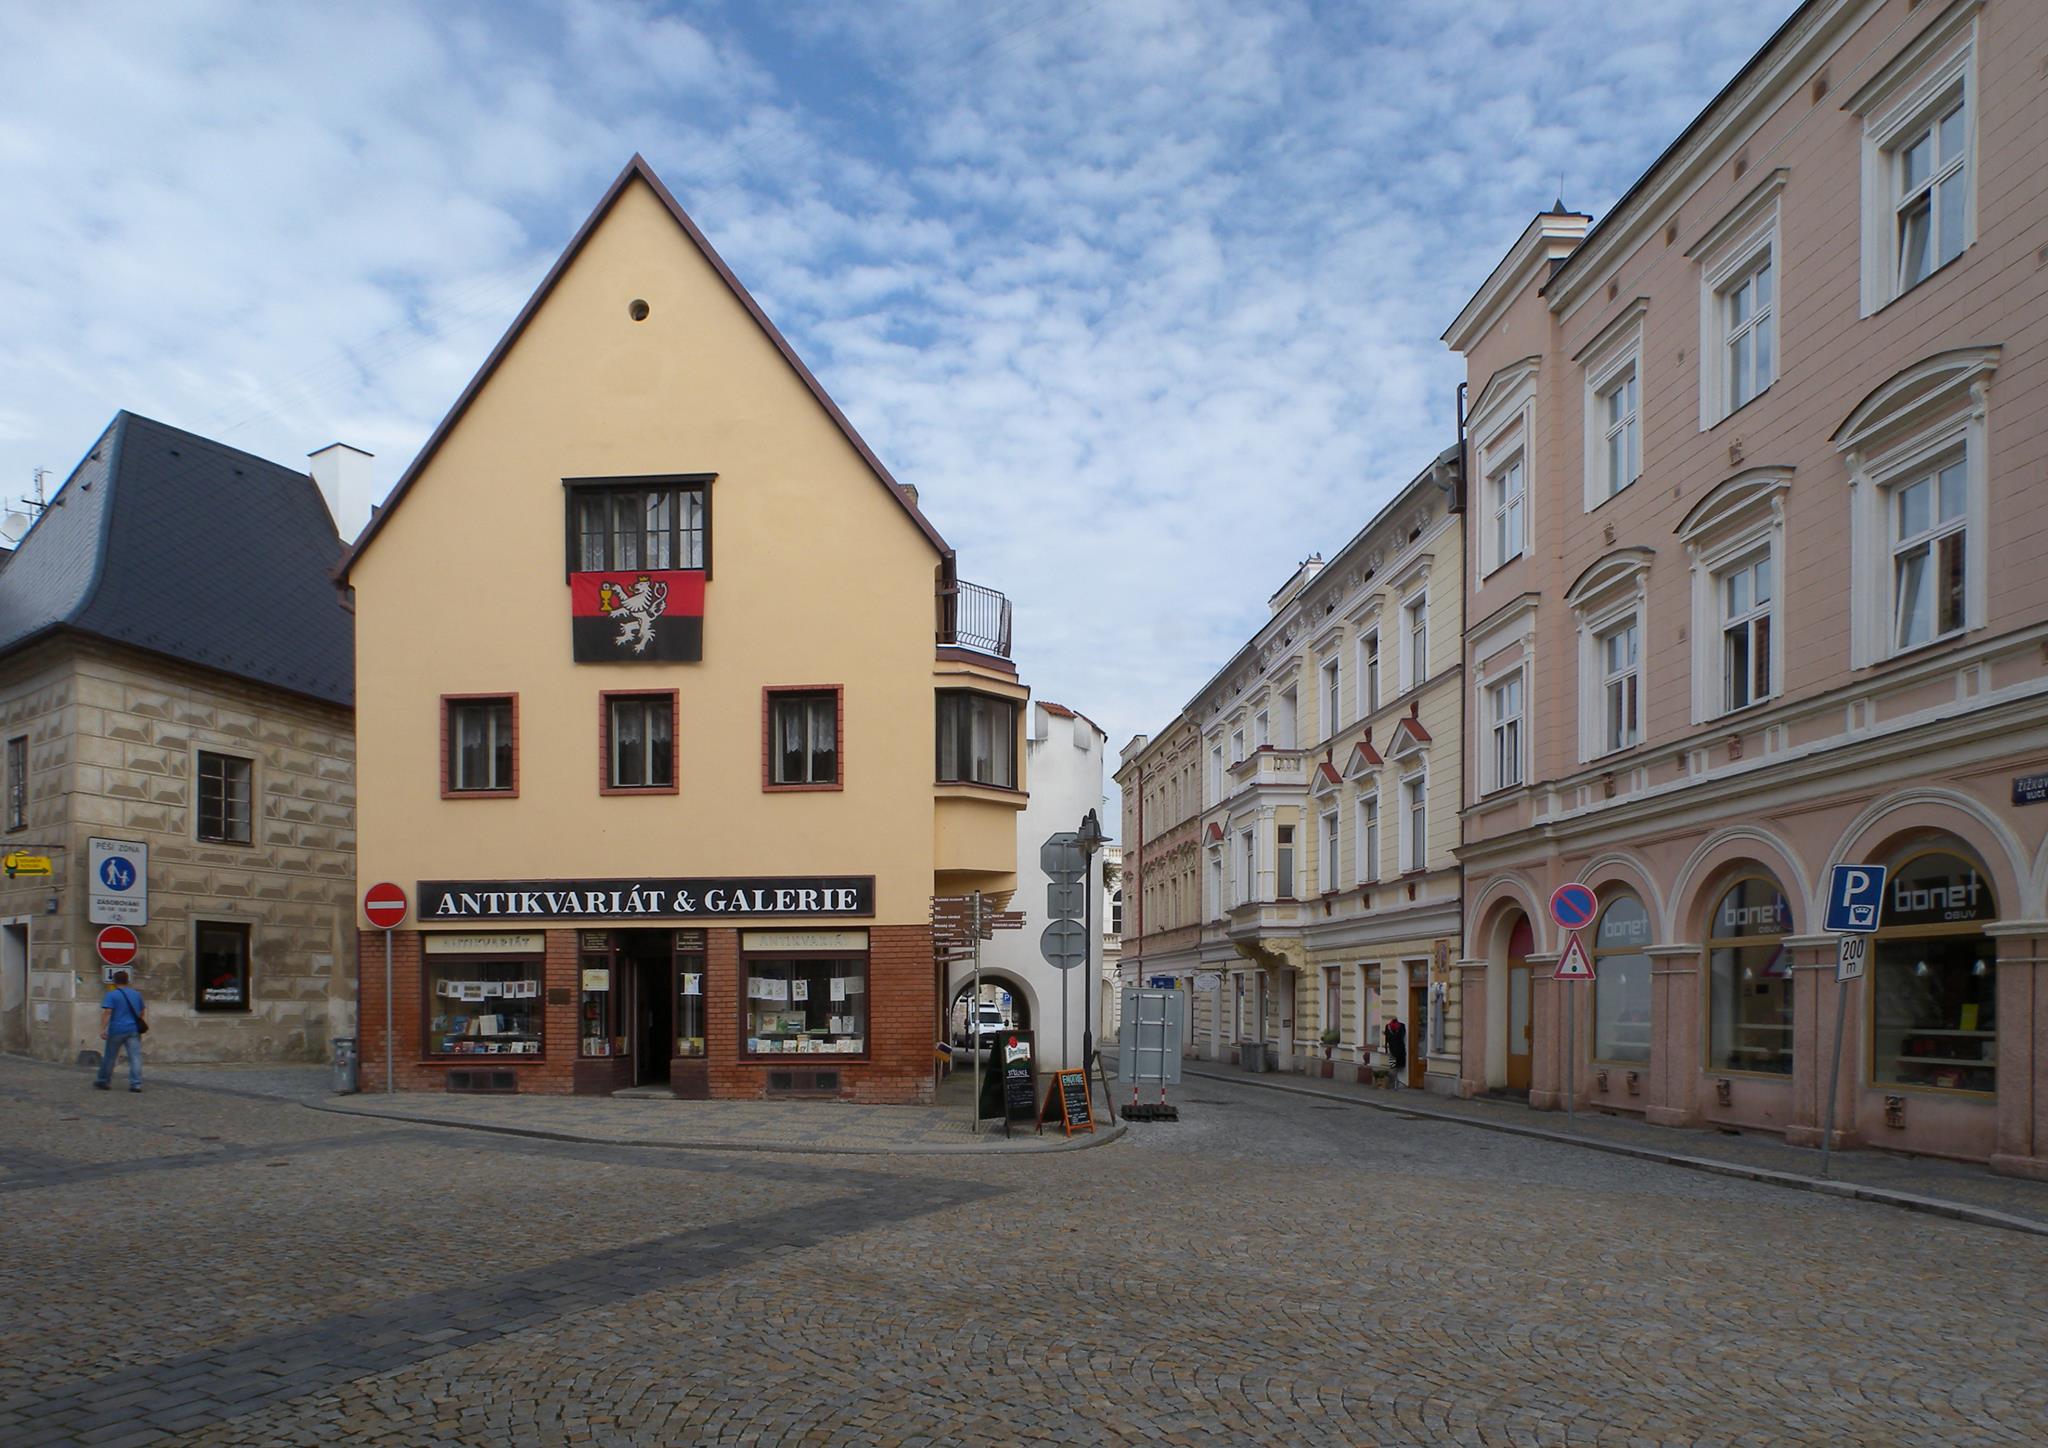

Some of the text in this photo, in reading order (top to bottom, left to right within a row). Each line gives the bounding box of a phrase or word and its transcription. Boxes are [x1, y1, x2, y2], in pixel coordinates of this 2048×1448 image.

[436, 884, 858, 915] ANTIKVARIÁT & GALERIE
[1842, 870, 1870, 907] P
[1894, 869, 1981, 912] bonet
[1725, 893, 1784, 926] bonet
[1945, 910, 1976, 920] OBUV
[1605, 911, 1648, 937] bonet
[1842, 939, 1864, 961] 200
[1846, 962, 1856, 974] m
